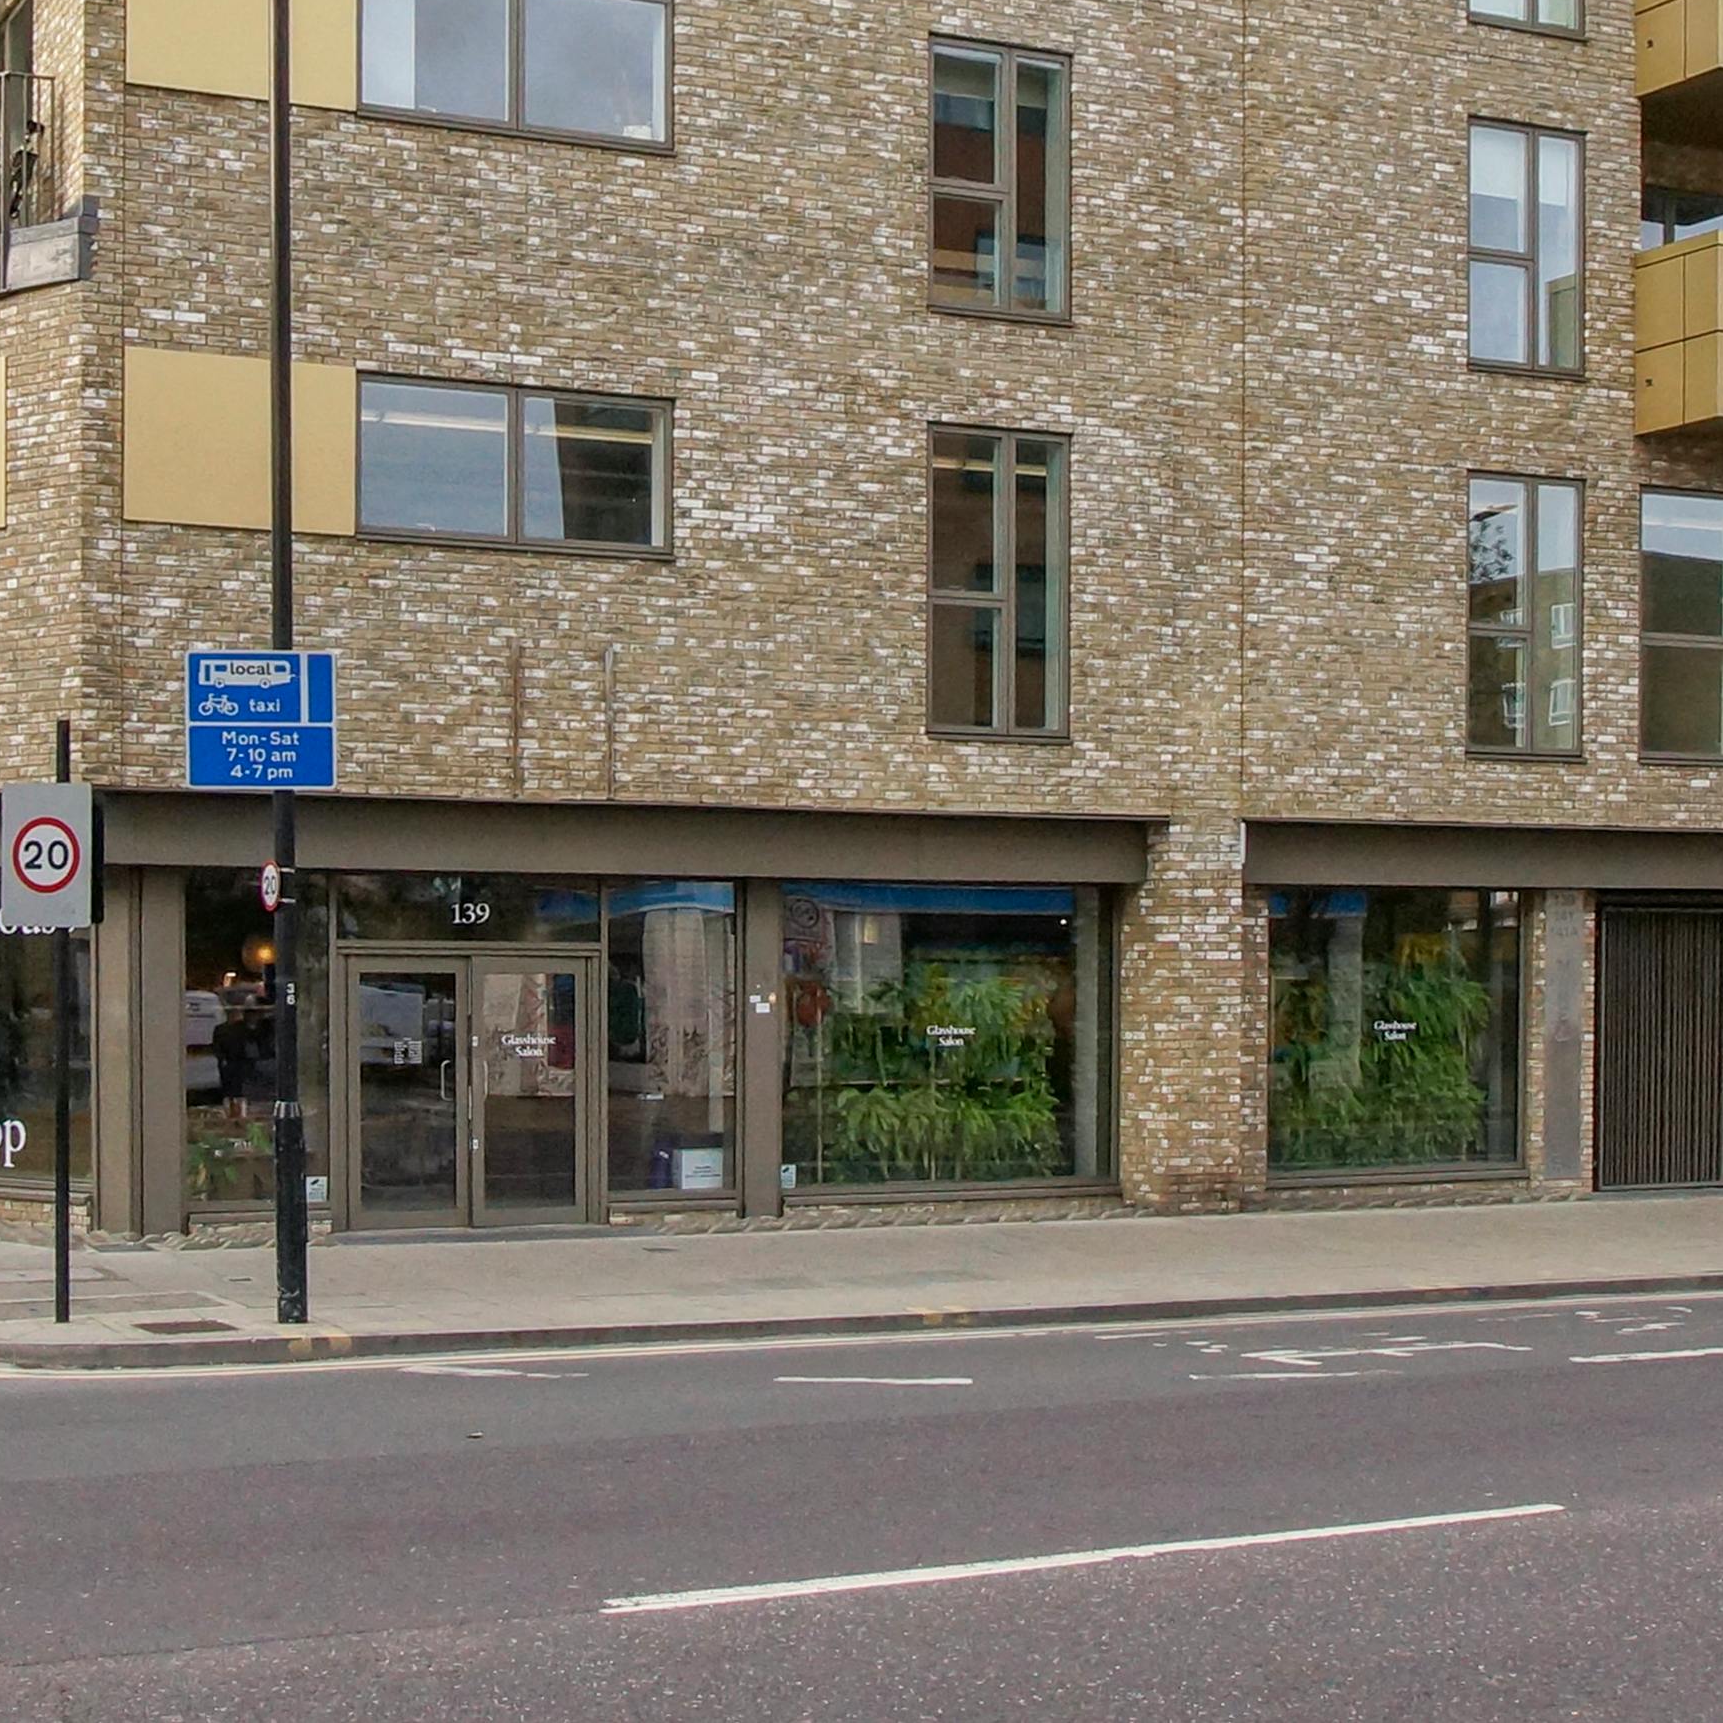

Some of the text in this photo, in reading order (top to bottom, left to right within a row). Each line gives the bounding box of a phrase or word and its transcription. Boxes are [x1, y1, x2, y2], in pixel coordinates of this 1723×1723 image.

[230, 662, 272, 676] local
[249, 698, 281, 713] taxi
[270, 750, 296, 762] am
[267, 767, 293, 781] pm
[23, 840, 69, 870] 20
[263, 875, 276, 896] 20
[451, 903, 490, 924] 139
[515, 1046, 543, 1057] Salon
